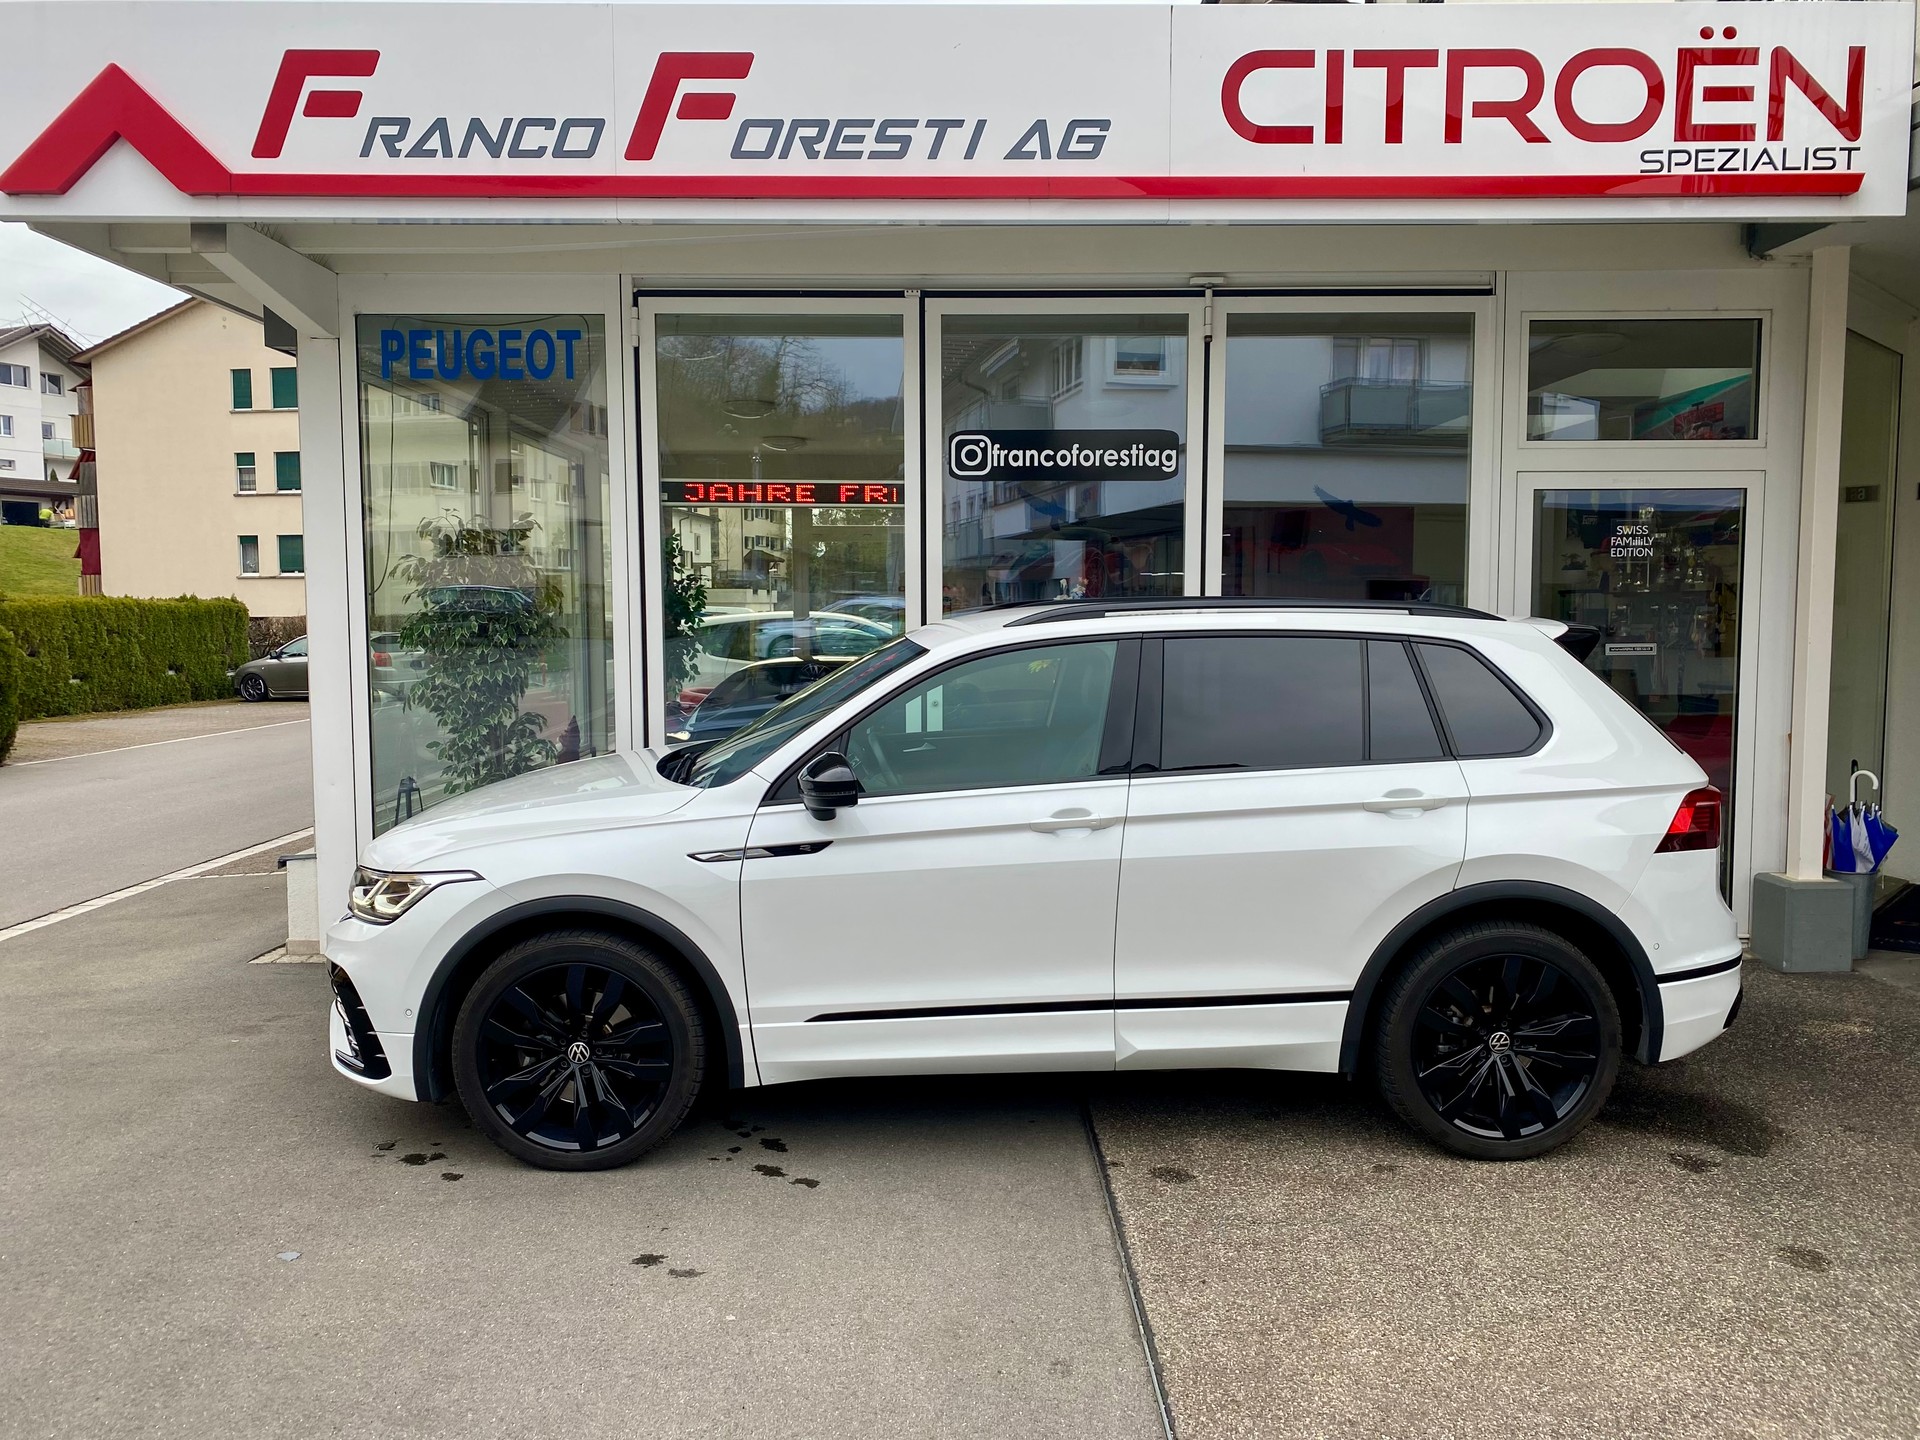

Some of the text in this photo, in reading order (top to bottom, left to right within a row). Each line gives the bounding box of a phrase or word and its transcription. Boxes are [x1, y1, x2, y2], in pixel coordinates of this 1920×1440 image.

[1221, 25, 1867, 144] CITROËN
[251, 49, 1112, 161] FRANCO FORESTI AG
[1640, 147, 1861, 173] SPEZIALIST
[381, 329, 581, 380] PEUGEOT
[992, 443, 1178, 473] francoforestiag
[685, 483, 815, 502] JAHRE
[1616, 525, 1649, 535] SWISS
[1610, 548, 1654, 557] EDITION
